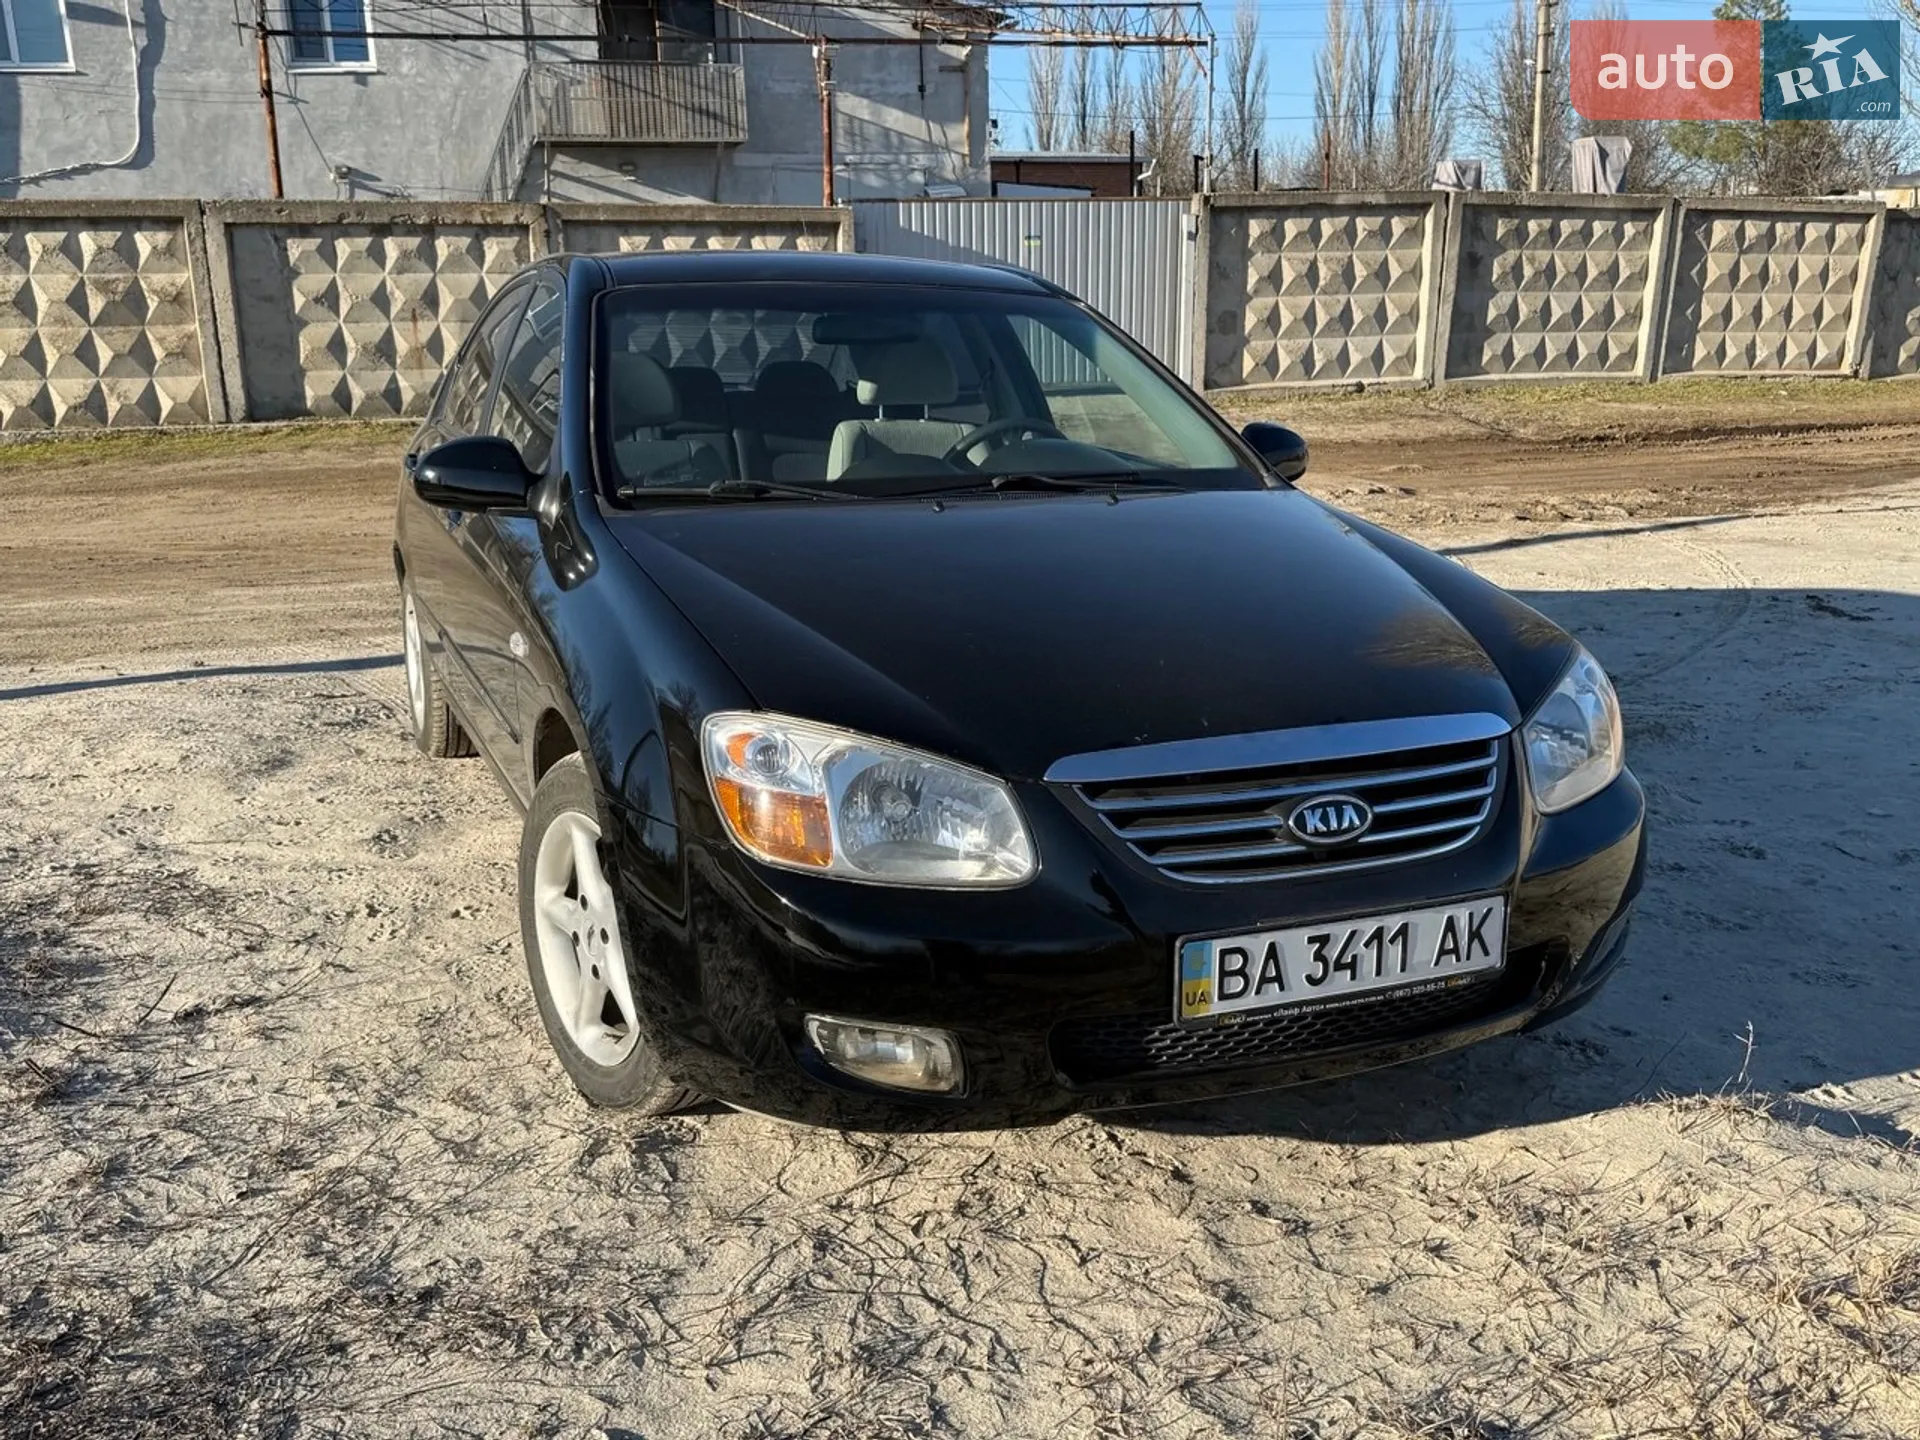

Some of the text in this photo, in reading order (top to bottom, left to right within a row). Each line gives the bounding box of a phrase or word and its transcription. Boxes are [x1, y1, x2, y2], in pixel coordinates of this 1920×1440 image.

[1303, 804, 1361, 834] KIA
[1217, 907, 1494, 1001] BA 3411 AK
[1186, 990, 1208, 1007] UA
